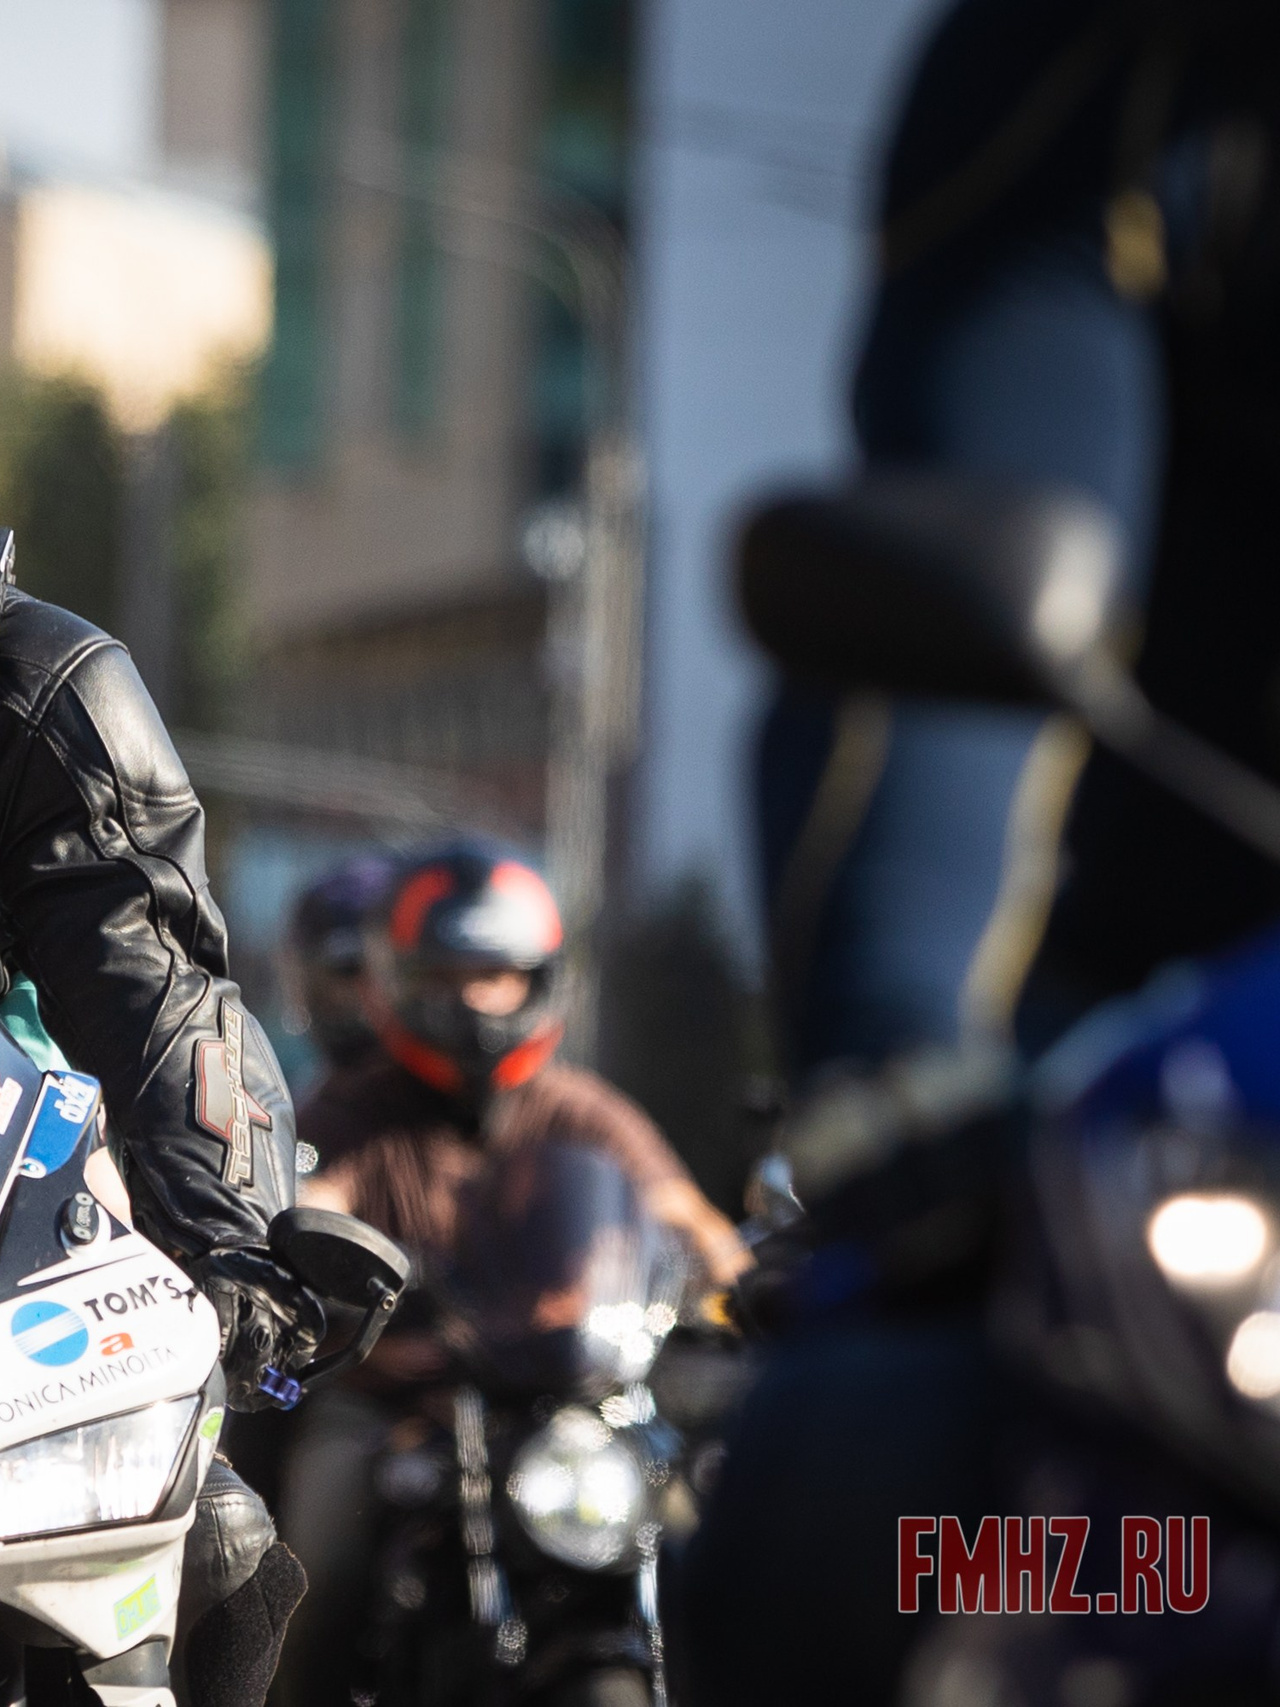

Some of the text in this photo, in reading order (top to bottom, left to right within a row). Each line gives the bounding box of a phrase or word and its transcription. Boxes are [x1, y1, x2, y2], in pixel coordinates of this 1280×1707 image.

[83, 1275, 184, 1322] TOM'S
[99, 1332, 135, 1357] a
[78, 1346, 180, 1394] MINOLTA
